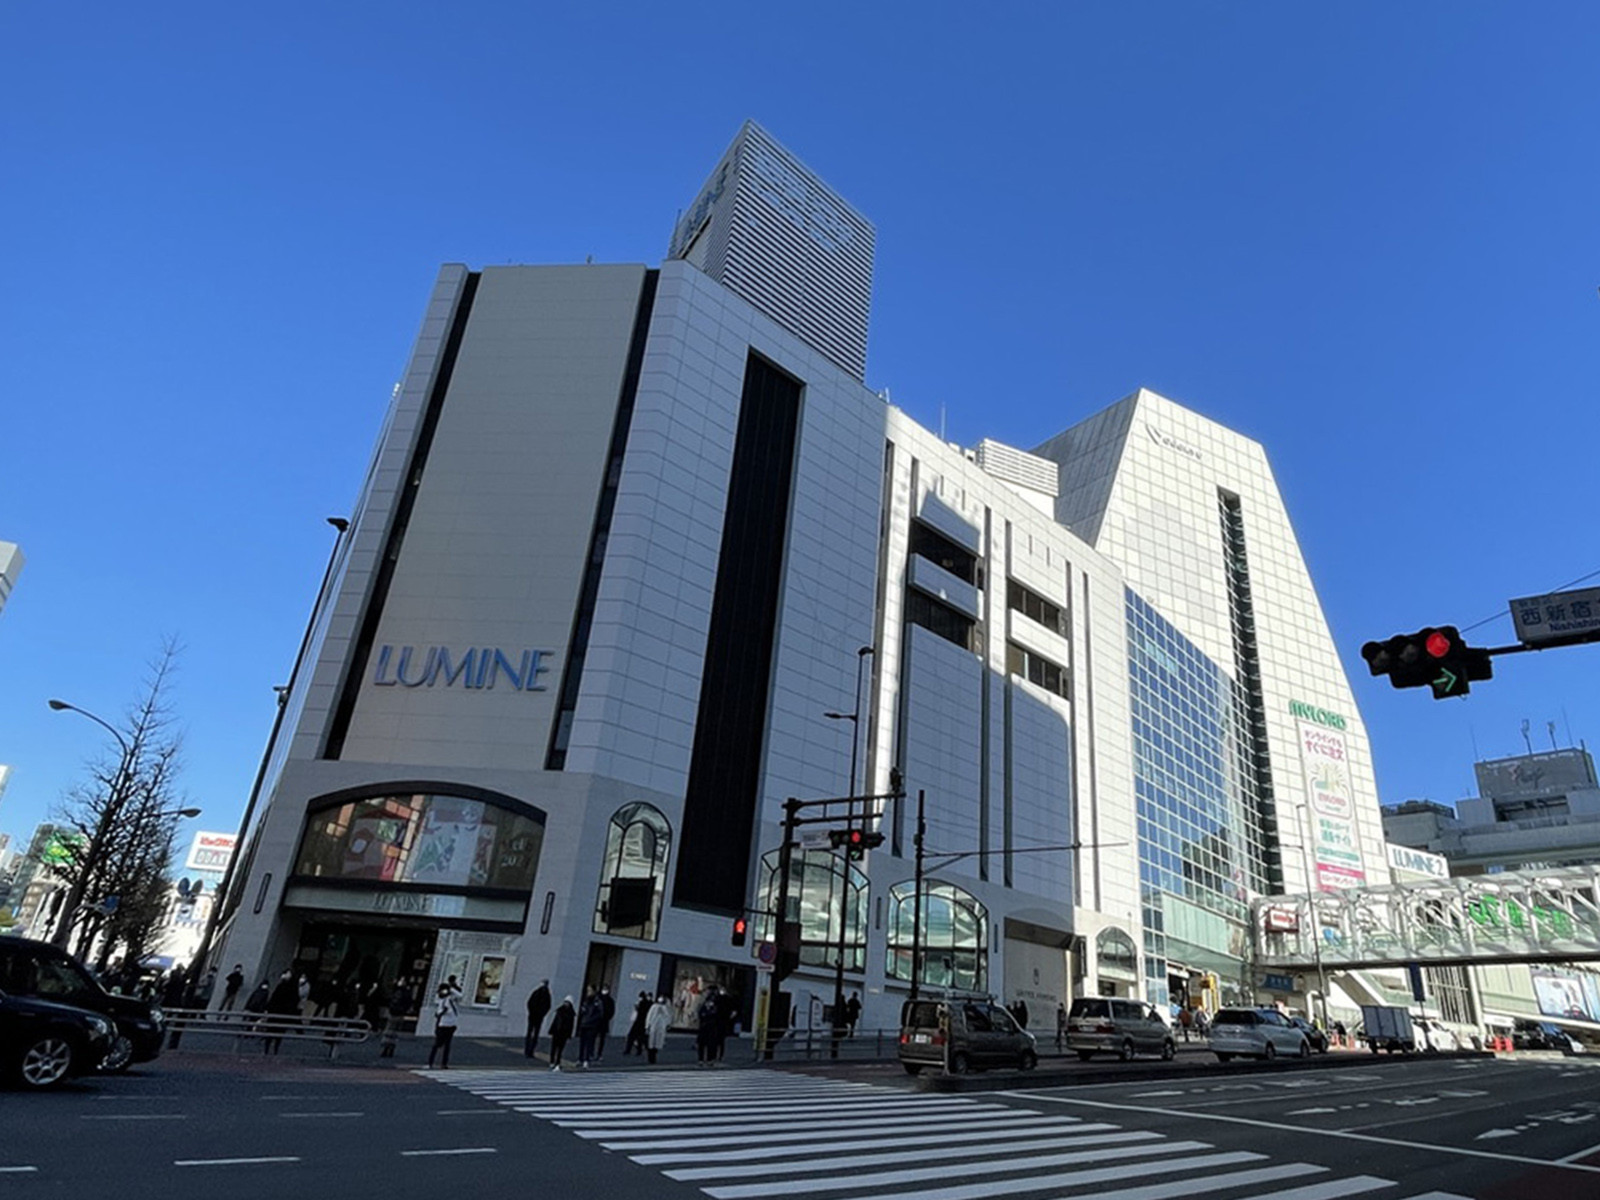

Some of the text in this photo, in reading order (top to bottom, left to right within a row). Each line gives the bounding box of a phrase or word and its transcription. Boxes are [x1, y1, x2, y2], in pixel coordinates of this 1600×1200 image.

[1520, 597, 1600, 626] 西新宿
[373, 644, 555, 692] LUMINE
[1288, 698, 1347, 731] MYLORD
[1392, 848, 1445, 877] LUMINE 2
